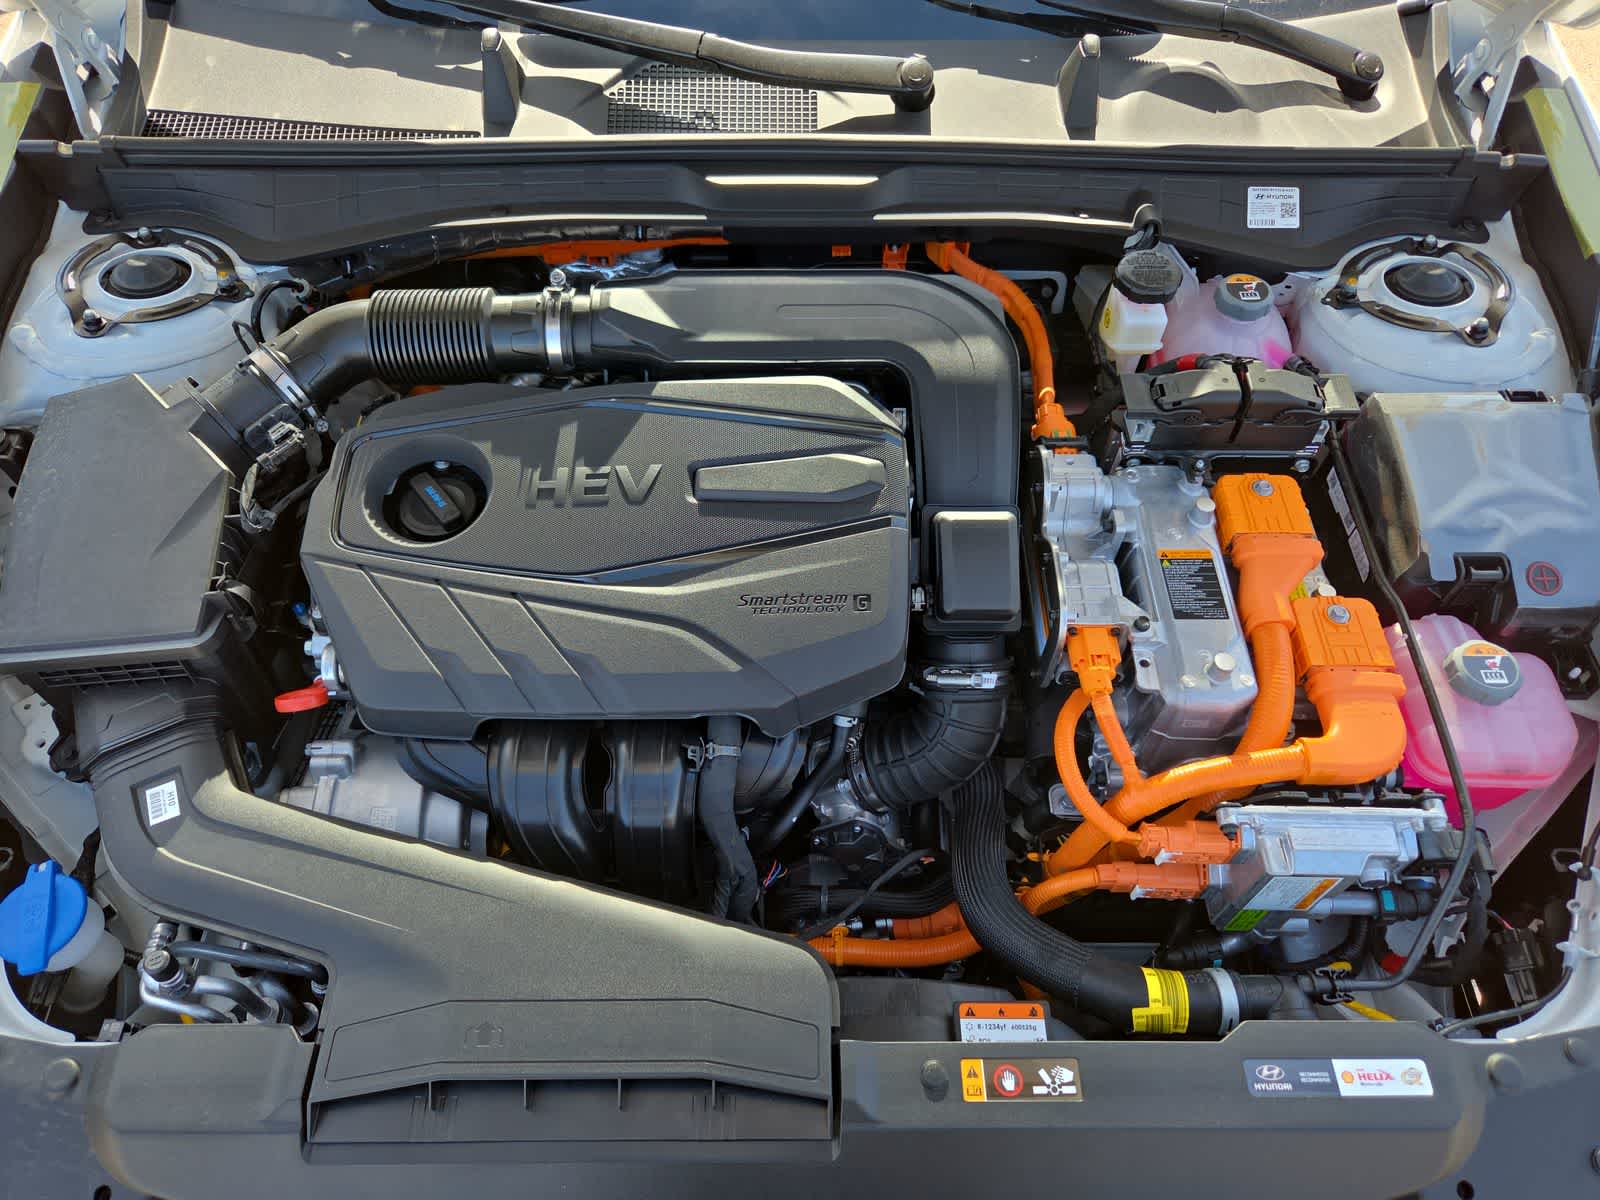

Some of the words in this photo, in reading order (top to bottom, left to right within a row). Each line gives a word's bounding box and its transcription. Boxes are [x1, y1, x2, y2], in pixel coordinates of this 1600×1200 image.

[525, 464, 663, 508] HEV
[737, 592, 848, 607] Smartstream
[853, 594, 871, 611] G
[751, 605, 847, 615] TECHNOLOGY
[1358, 1071, 1394, 1081] HELIX
[1254, 1082, 1293, 1091] HYUNDAI
